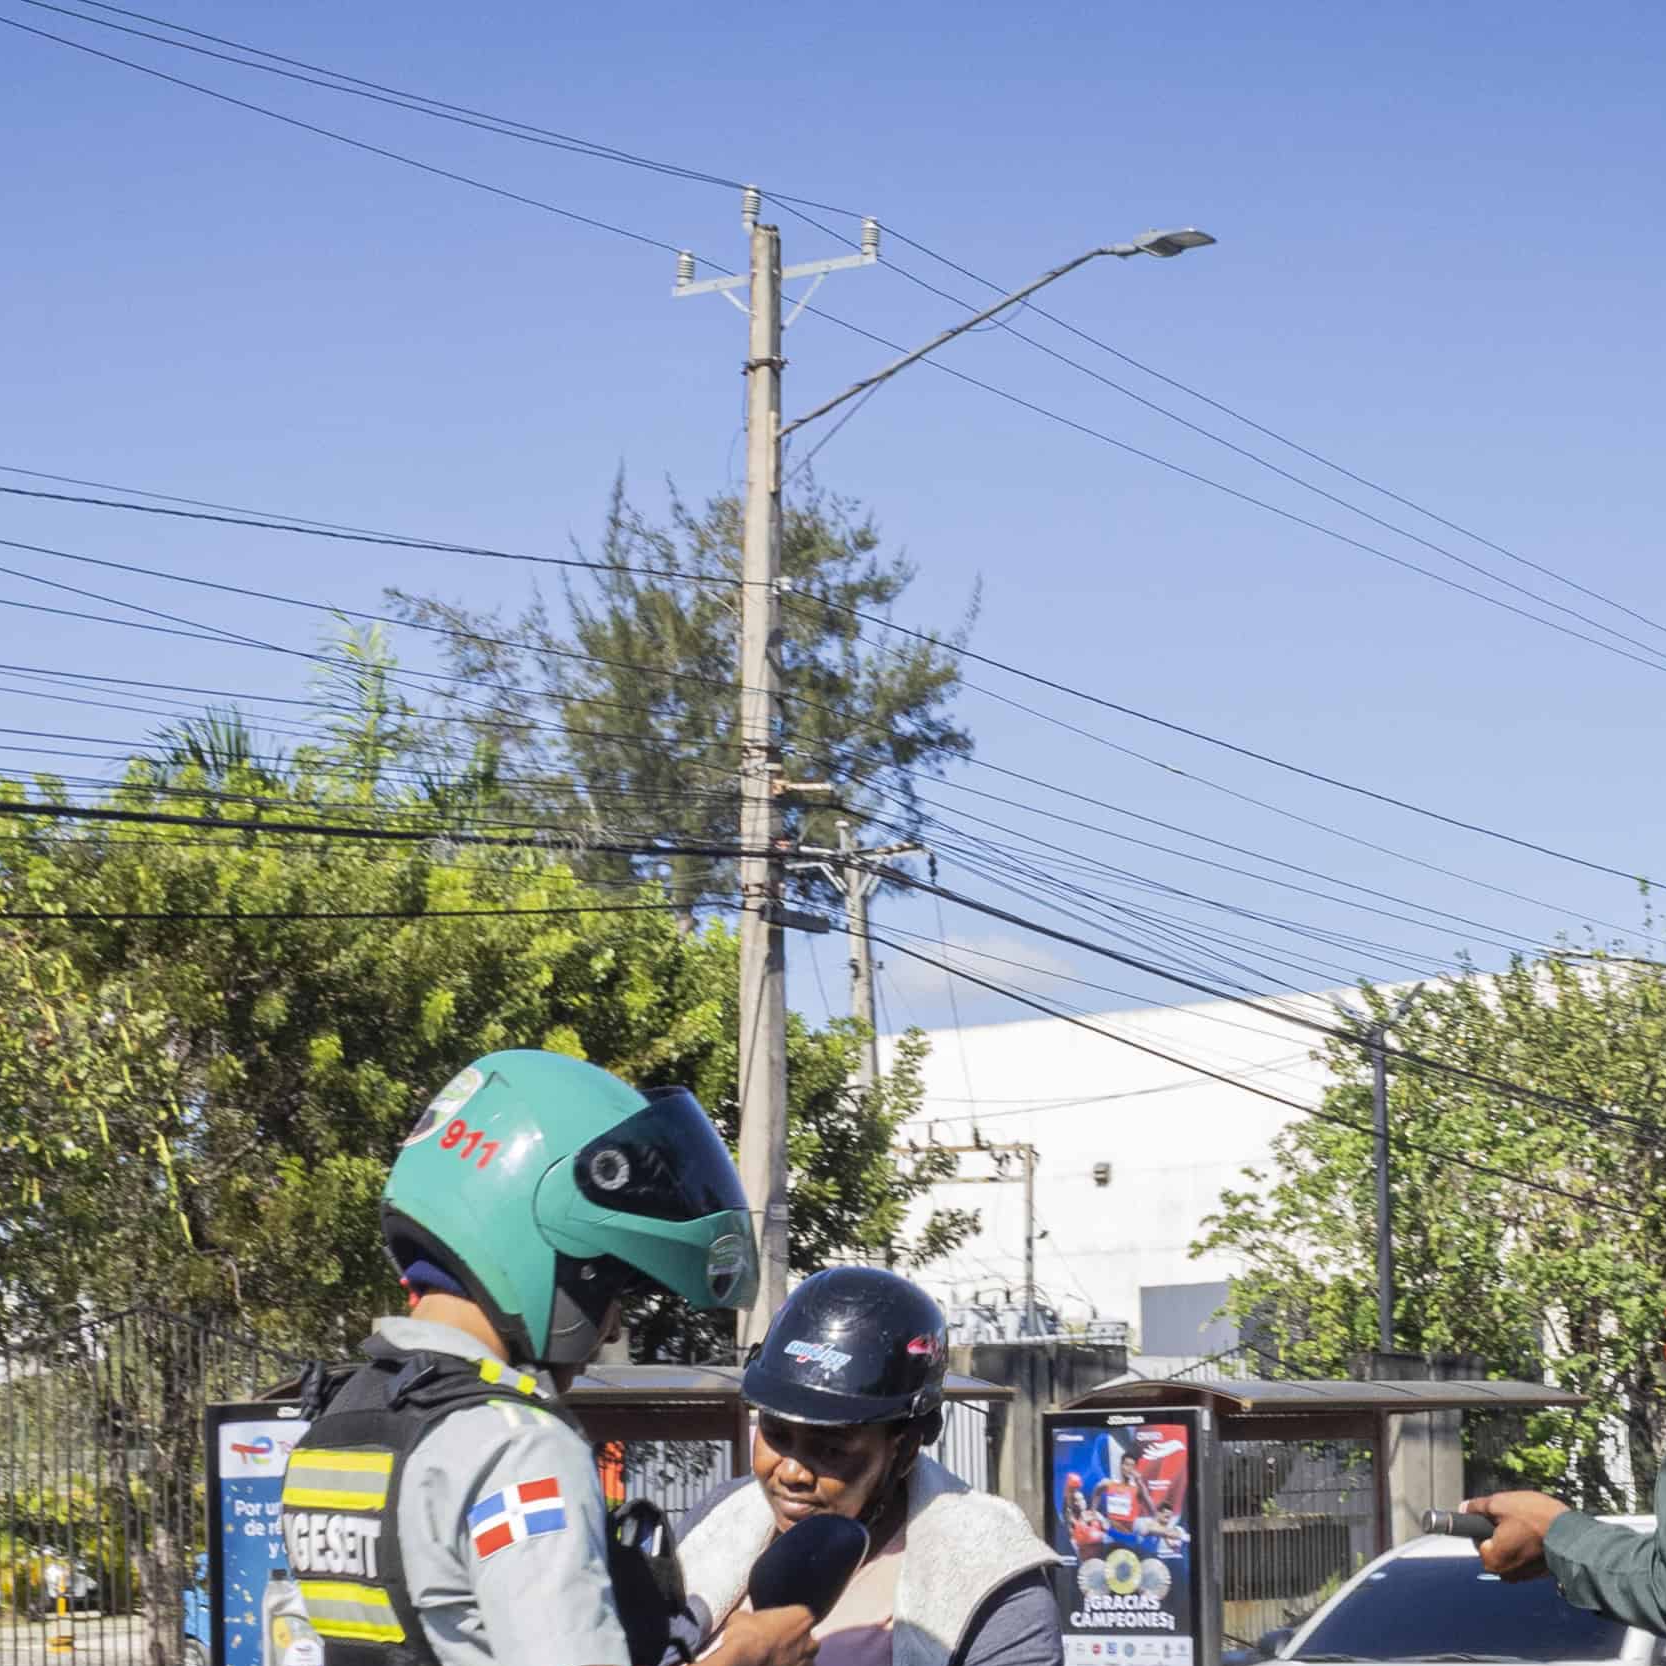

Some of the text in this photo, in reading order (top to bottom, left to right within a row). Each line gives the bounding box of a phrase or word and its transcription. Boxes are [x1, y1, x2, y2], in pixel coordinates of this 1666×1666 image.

[439, 1119, 501, 1170] 911
[234, 1499, 262, 1516] Por
[244, 1519, 266, 1536] de
